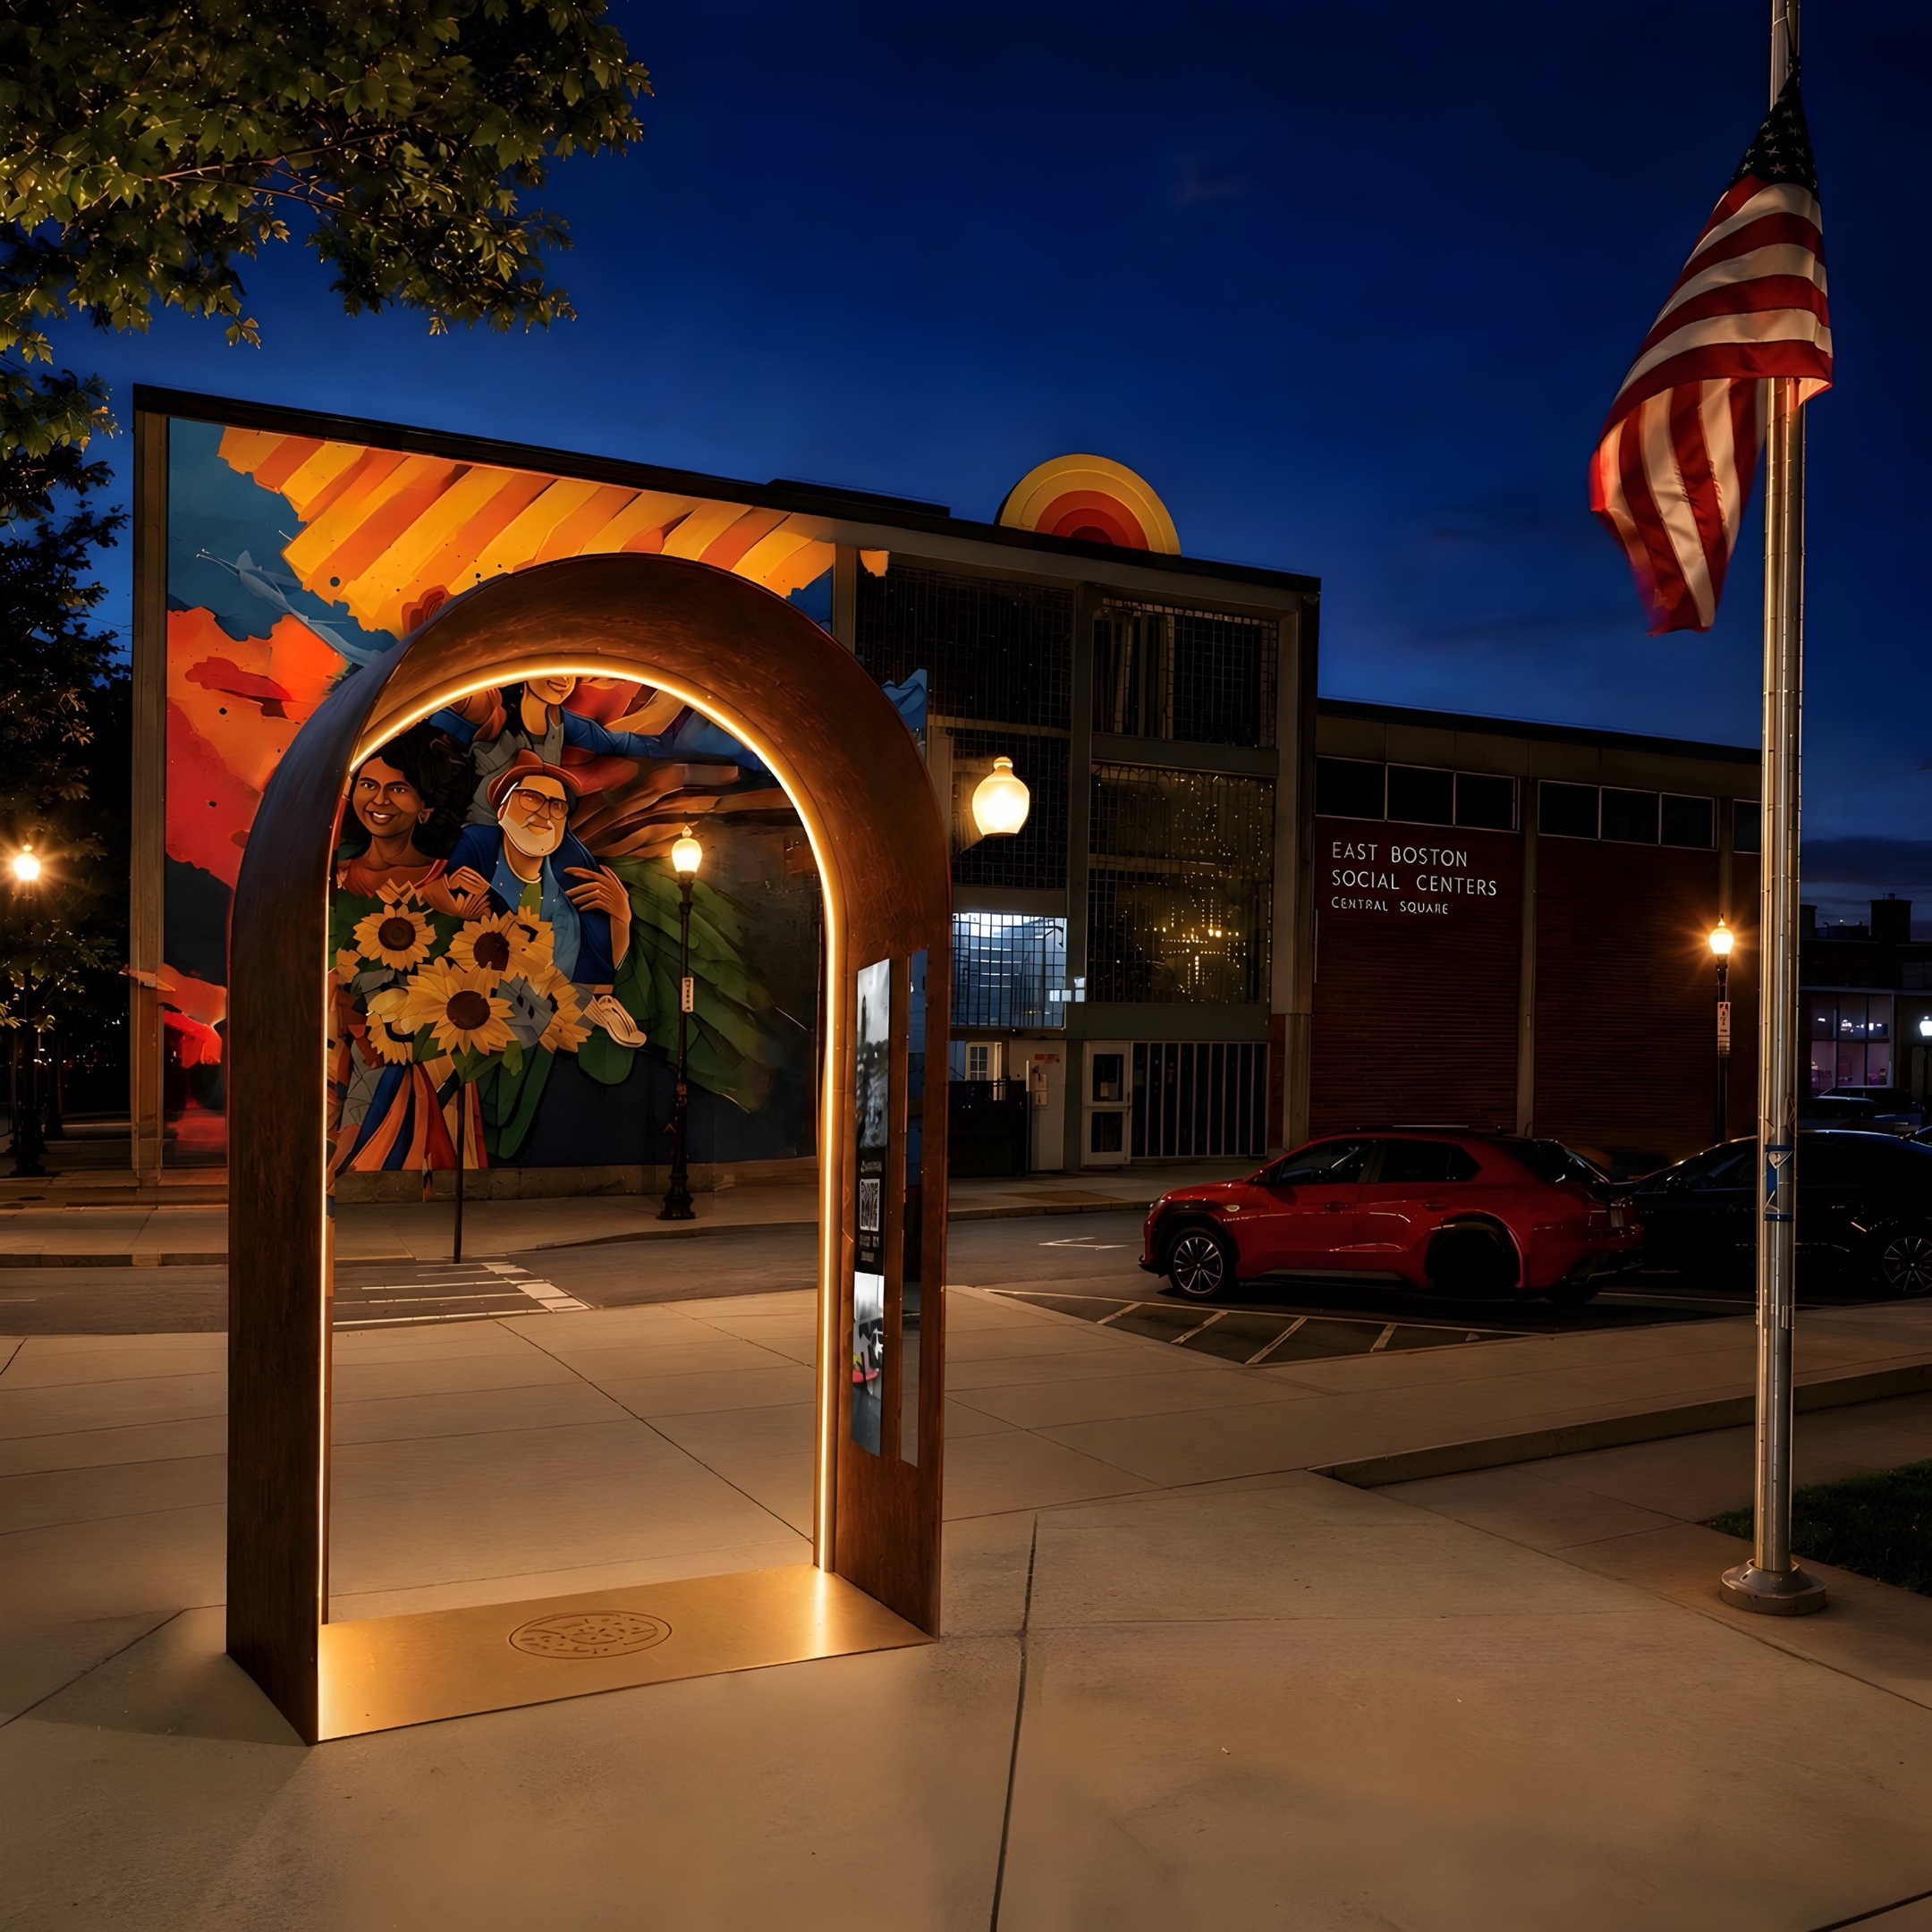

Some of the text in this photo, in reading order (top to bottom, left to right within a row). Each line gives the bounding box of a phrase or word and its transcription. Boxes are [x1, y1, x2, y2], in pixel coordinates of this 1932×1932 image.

[1333, 842, 1467, 868] EAST BOSTON
[1332, 869, 1497, 896] SOCIAL CENTERS
[1331, 896, 1449, 915] CENTRAL SQUARE
